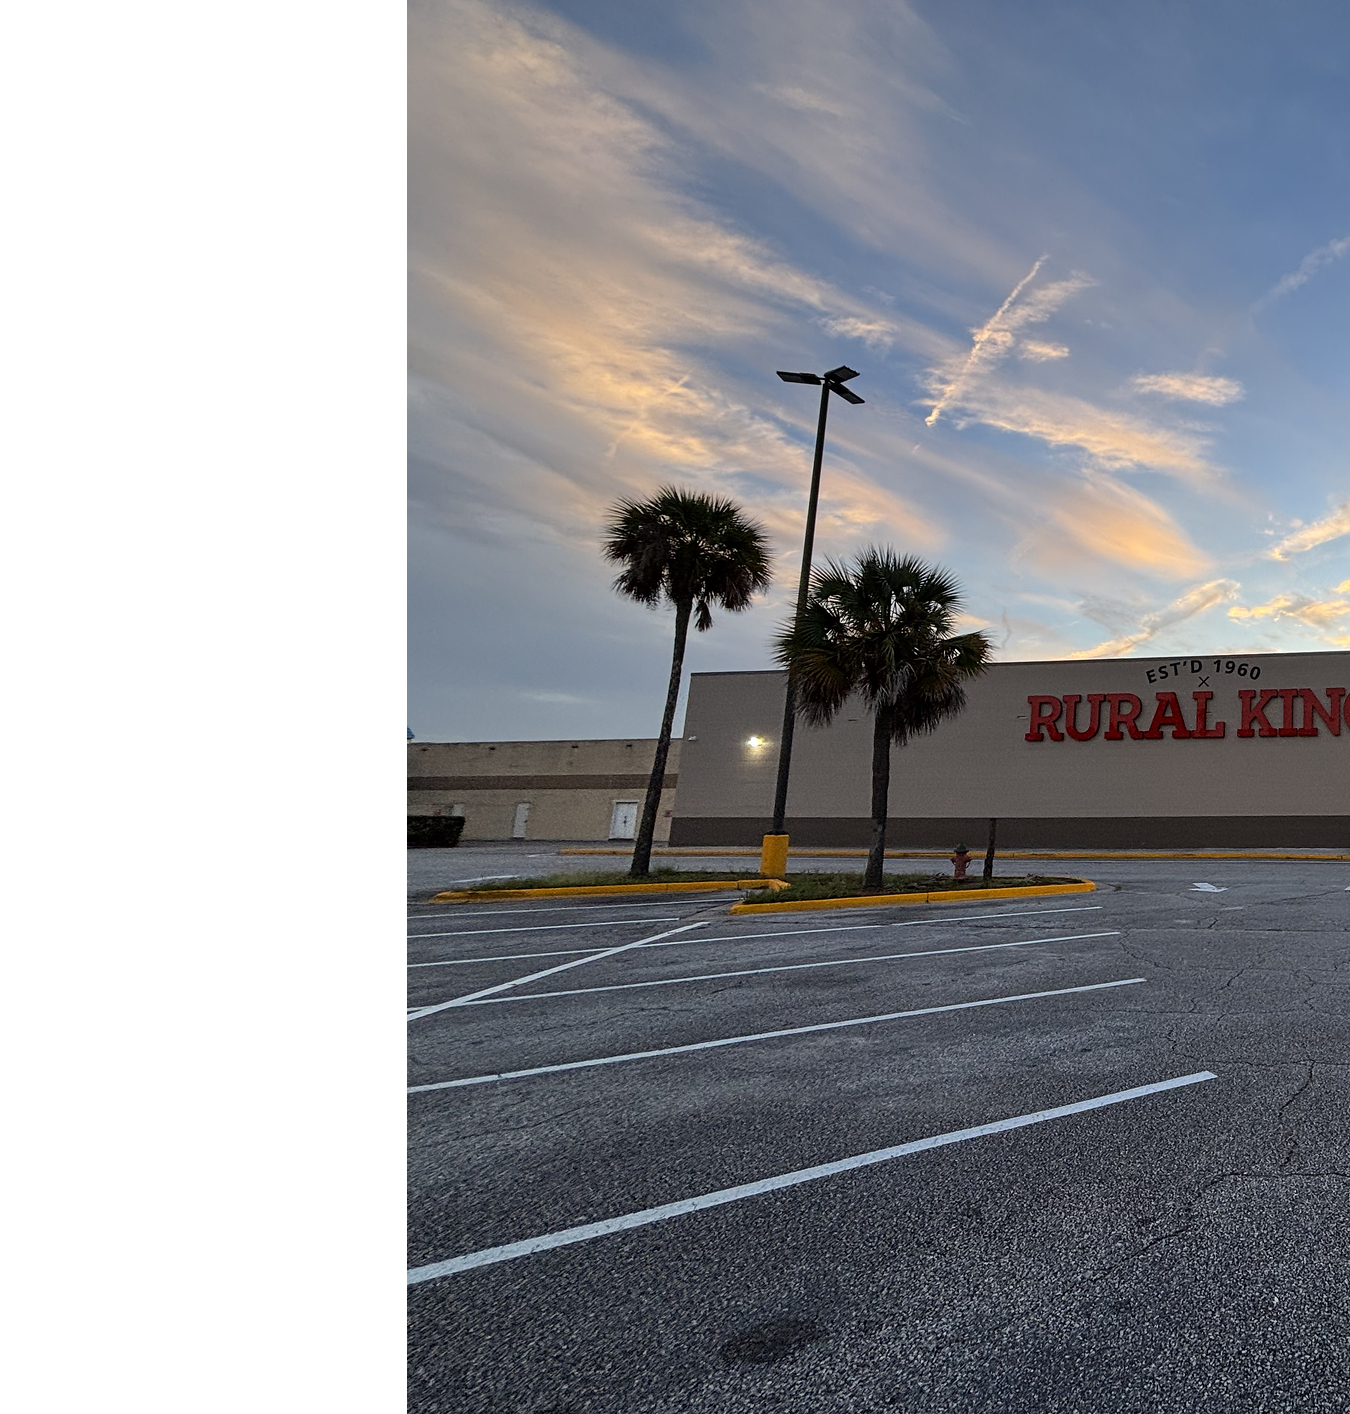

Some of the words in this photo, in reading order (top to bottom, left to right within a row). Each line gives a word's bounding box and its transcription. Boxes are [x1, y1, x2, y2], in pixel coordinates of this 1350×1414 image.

[1145, 660, 1202, 684] EST'D
[1213, 659, 1262, 681] 1960
[1024, 691, 1226, 743] RURAL
